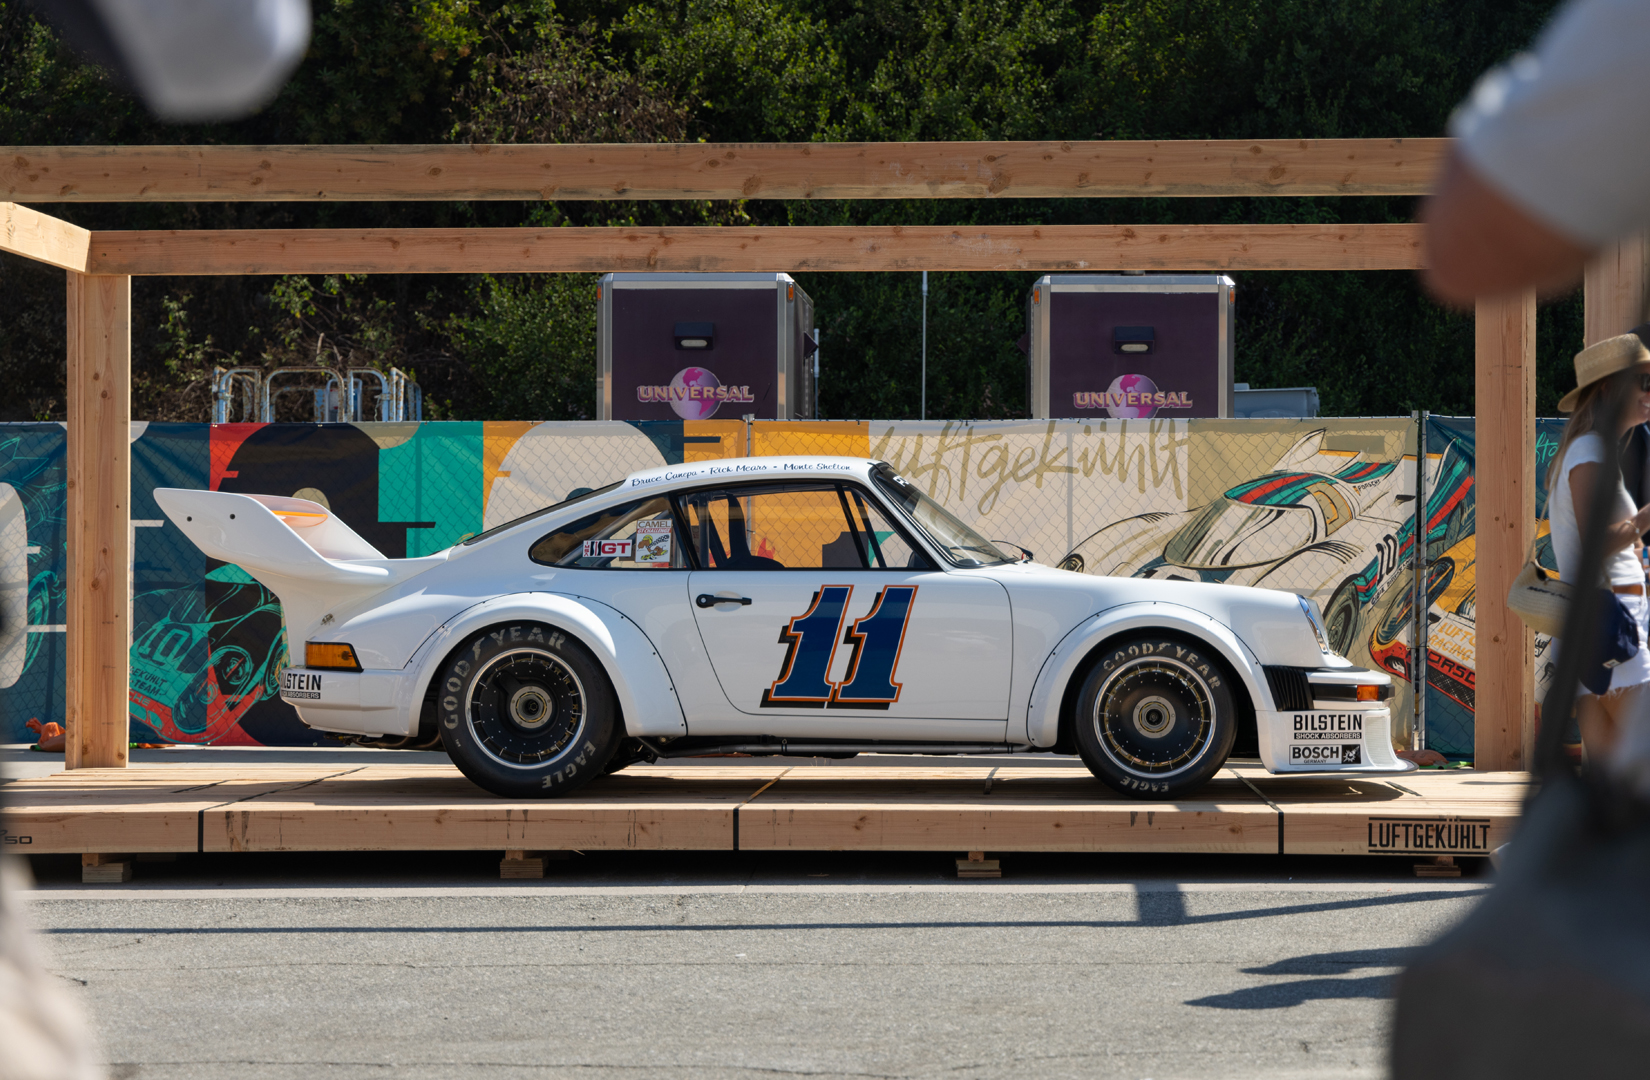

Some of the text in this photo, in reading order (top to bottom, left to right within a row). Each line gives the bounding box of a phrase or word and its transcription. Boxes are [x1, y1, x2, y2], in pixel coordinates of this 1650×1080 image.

[637, 385, 755, 402] UNIVERSAL
[1073, 391, 1193, 408] UNIVERSAL
[631, 462, 851, 487] Bruce Canepa Rick Mears Monte Shelton
[601, 542, 631, 554] GT
[759, 584, 919, 710] 11
[1428, 634, 1474, 661] RACING
[1294, 714, 1362, 731] BILSTEIN
[1292, 746, 1339, 759] BOSCH
[541, 740, 596, 789] EAGLE
[1120, 775, 1169, 792] EAGLE
[1368, 818, 1491, 849] LUFTGEKÜHLT
